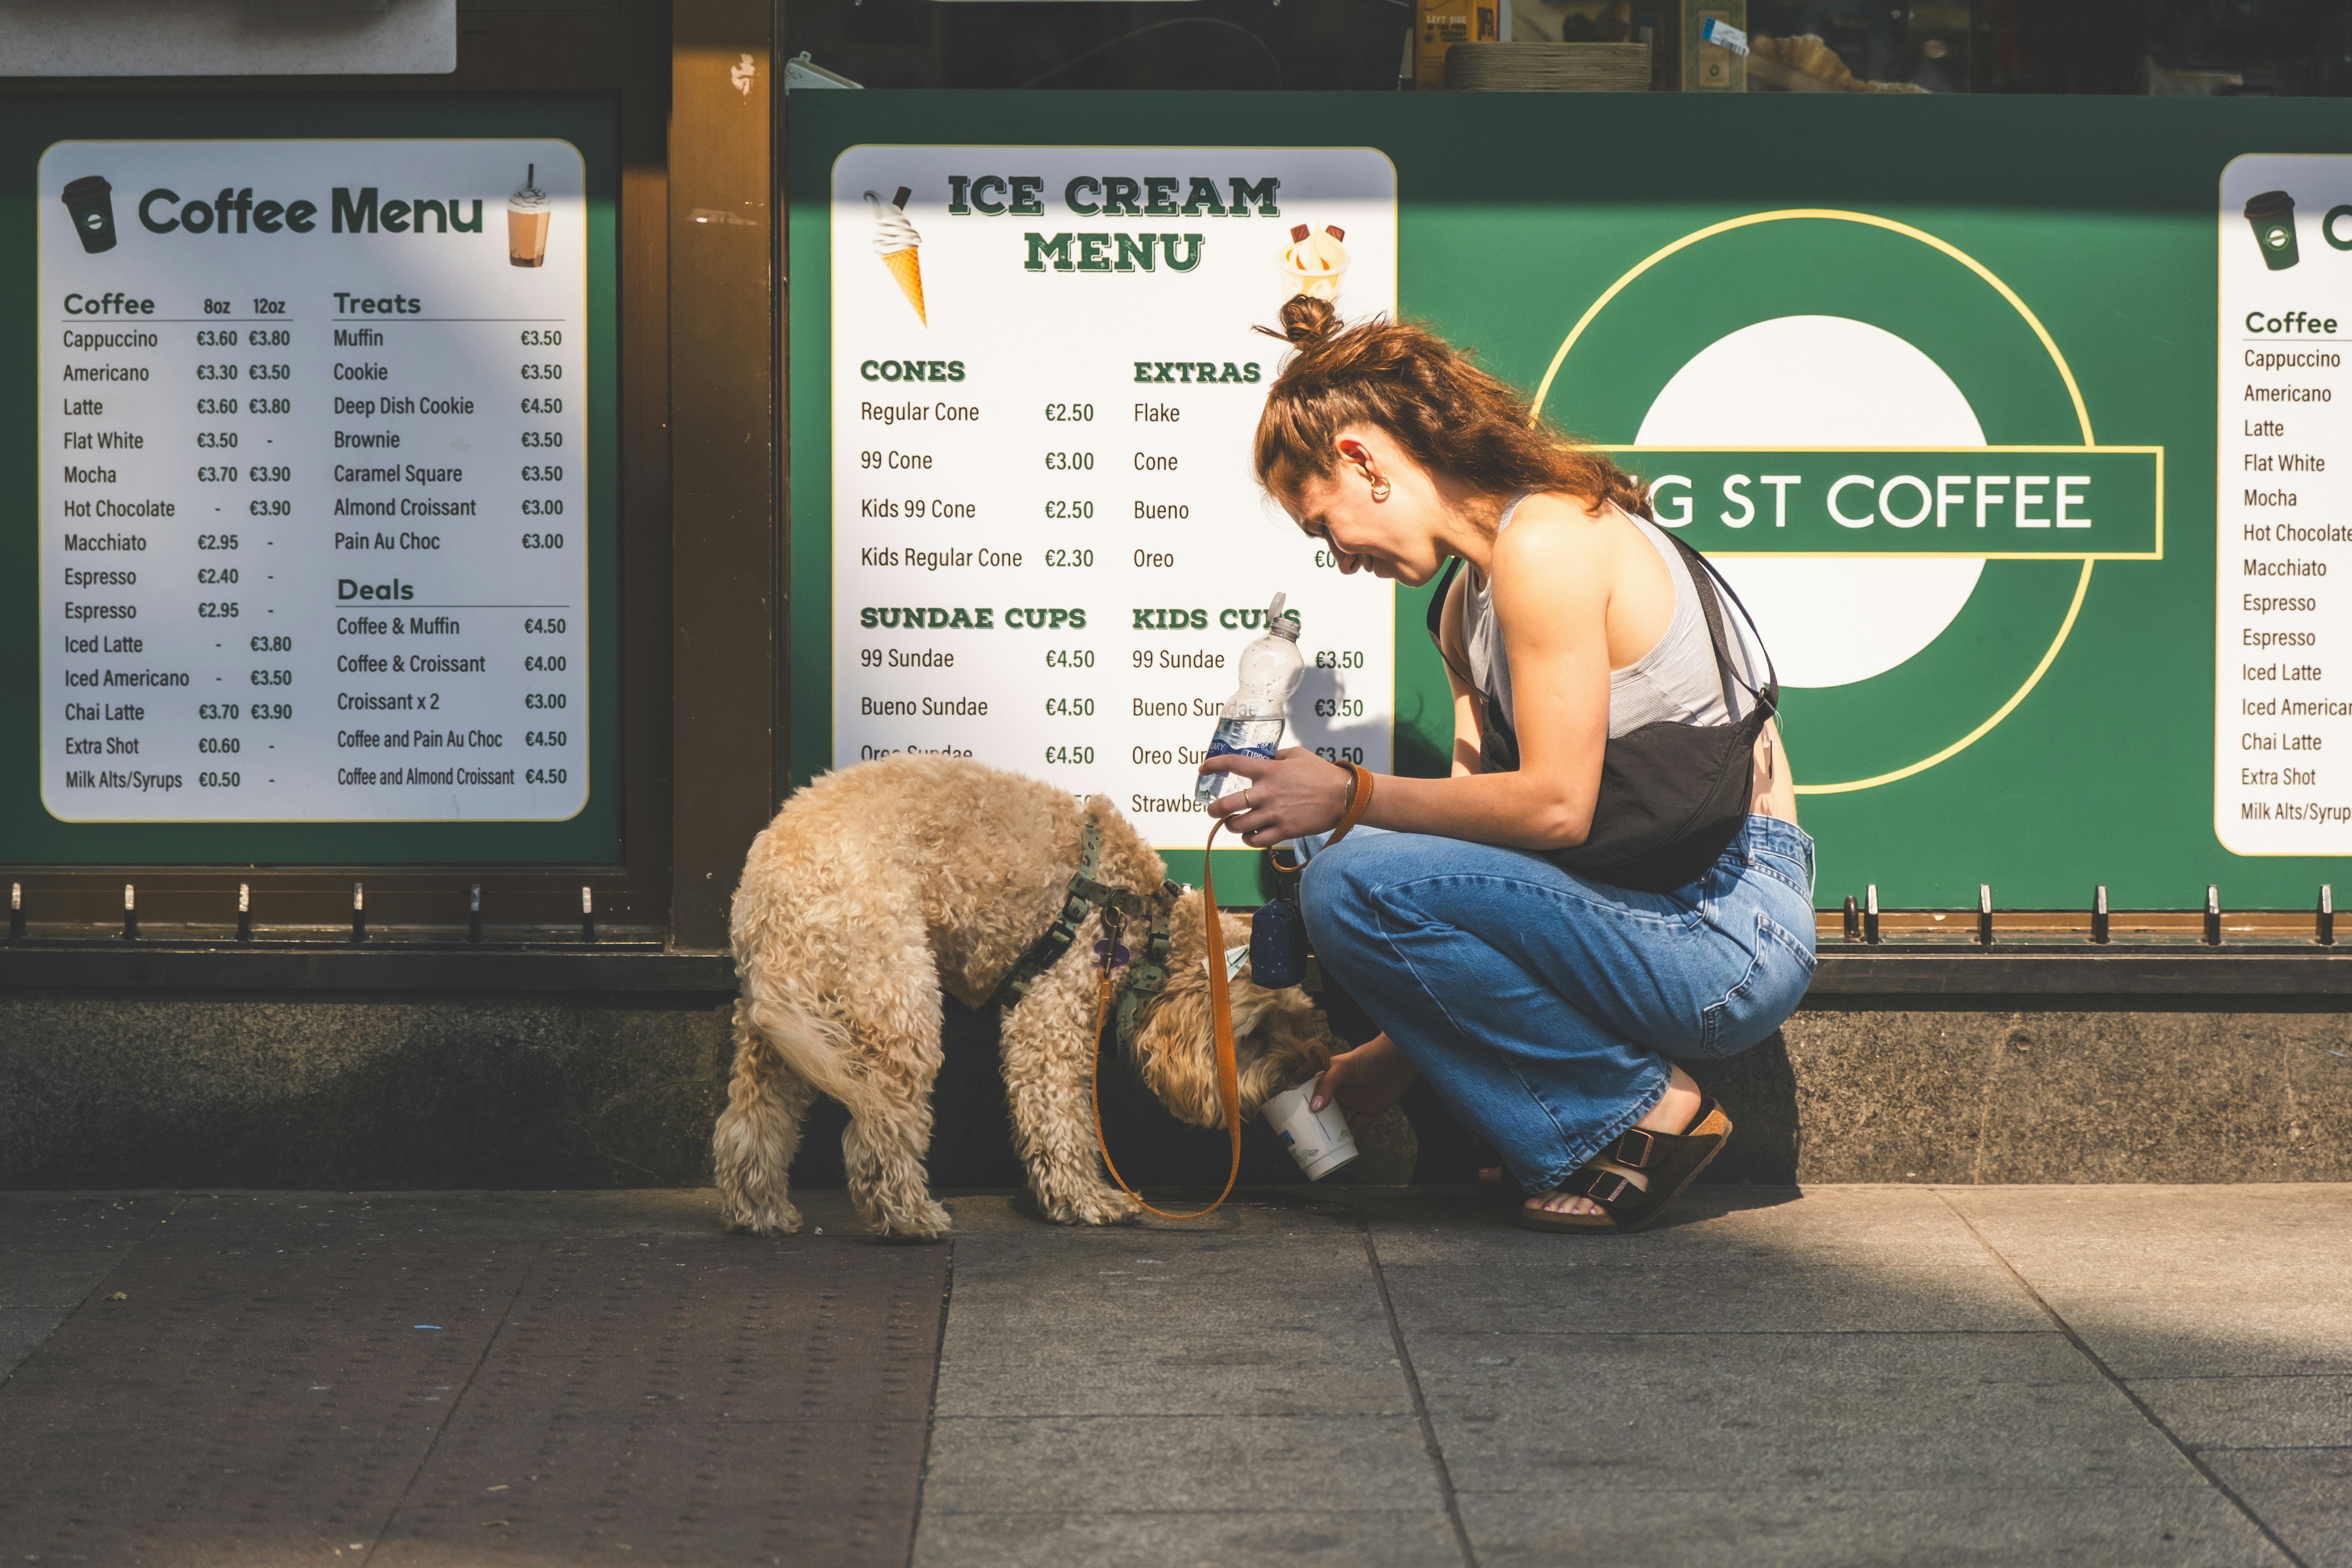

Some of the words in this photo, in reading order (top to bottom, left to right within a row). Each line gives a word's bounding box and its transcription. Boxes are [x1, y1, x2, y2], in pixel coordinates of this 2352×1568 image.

[948, 175, 1045, 217] ICE
[1064, 176, 1280, 218] CREAM
[139, 188, 317, 234] Coffee
[332, 187, 484, 233] Menu
[1024, 232, 1205, 273] MENU
[64, 292, 155, 315] Coffee
[204, 298, 231, 314] 8oz
[253, 298, 285, 314] 12oz
[333, 292, 421, 314] Treats
[2246, 311, 2338, 334] Coffee
[63, 329, 158, 351] Cappuccino
[196, 330, 238, 346] €3.60
[249, 330, 290, 346] €3.80
[334, 328, 383, 346] Muffin
[521, 330, 562, 346] €3.50
[2245, 349, 2340, 371] Cappuccino
[63, 363, 149, 381] Americano
[196, 364, 238, 380] €3.30
[249, 364, 290, 380] €3.50
[334, 362, 388, 381] Cookie
[521, 364, 562, 380] €3.50
[860, 360, 965, 382] CONES
[1134, 362, 1261, 383] EXTRAS
[2244, 384, 2331, 402] Americano
[64, 398, 103, 415] Latte
[197, 398, 238, 414] €3.60
[249, 398, 291, 414] €3.80
[334, 397, 375, 418] Deep
[380, 396, 415, 414] Dish
[420, 396, 474, 414] Cookie
[521, 398, 563, 414] €4.50
[862, 401, 929, 425] Regular
[935, 402, 979, 421] Cone
[1045, 403, 1094, 422] €2.50
[1135, 403, 1180, 422] Flake
[2245, 420, 2284, 437] Latte
[64, 432, 93, 449] Flat
[97, 431, 144, 449] White
[197, 432, 238, 448] €3.50
[334, 430, 400, 448] Brownie
[521, 432, 563, 447] €3.50
[861, 451, 882, 469] 99
[888, 450, 932, 469] Cone
[1045, 452, 1094, 470] €3.00
[1134, 452, 1178, 471] Cone
[64, 466, 116, 483] Mocha
[197, 466, 238, 482] €3.70
[249, 466, 291, 482] €3.90
[334, 464, 400, 482] Caramel
[405, 464, 462, 486] Square
[521, 466, 563, 481] €3.50
[64, 500, 91, 517] Hot
[96, 499, 175, 517] Chocolate
[250, 500, 291, 516] €3.90
[334, 498, 395, 516] Almond
[400, 498, 476, 516] Croissant
[521, 499, 564, 515] €3.00
[862, 498, 899, 518] Kids
[904, 499, 925, 518] 99
[932, 499, 975, 518] Cone
[1045, 501, 1093, 519] €2.50
[1135, 501, 1189, 519] Bueno
[1629, 474, 1693, 528] G
[1720, 474, 1801, 528] ST
[1827, 475, 2092, 528] COFFEE
[64, 533, 147, 551] Macchiato
[198, 534, 239, 550] €2.95
[335, 531, 369, 550] Pain
[374, 532, 395, 550] Au
[400, 531, 440, 550] Choc
[522, 533, 564, 549] €3.00
[2244, 524, 2271, 541] Hot
[2276, 524, 2352, 542] Chocolate
[862, 547, 899, 566] Kids
[905, 547, 973, 571] Regular
[978, 548, 1022, 567] Cone
[1045, 549, 1093, 567] €2.30
[1134, 549, 1174, 568] Oreo
[65, 568, 136, 589] Espresso
[198, 568, 239, 584] €2.40
[338, 578, 414, 600] Deals
[65, 602, 137, 623] Espresso
[198, 602, 239, 618] €2.95
[861, 607, 994, 629] SUNDAE
[1005, 608, 1086, 629] CUPS
[1132, 608, 1208, 629] KIDS
[337, 616, 387, 635] Coffee
[392, 617, 404, 635] &
[410, 616, 459, 635] Muffin
[524, 618, 566, 634] €4.50
[65, 635, 98, 653] Iced
[104, 635, 143, 653] Latte
[250, 636, 292, 652] €3.80
[337, 654, 388, 672] Coffee
[392, 655, 405, 672] &
[410, 654, 485, 672] Croissant
[524, 656, 567, 671] €4.00
[861, 649, 882, 667] 99
[888, 648, 954, 668] Sundae
[1046, 650, 1095, 668] €4.50
[1133, 650, 1153, 668] 99
[1159, 649, 1225, 668] Sundae
[1315, 651, 1363, 668] €3.50
[65, 669, 99, 687] Iced
[103, 669, 190, 687] Americano
[250, 670, 292, 686] €3.50
[2243, 663, 2276, 681] Iced
[2282, 664, 2321, 681] Latte
[337, 692, 413, 710] Croissant
[417, 697, 426, 710] x
[430, 693, 439, 710] 2
[525, 693, 567, 709] €3.00
[862, 697, 917, 715] Bueno
[922, 697, 988, 716] Sundae
[1046, 698, 1094, 716] €4.50
[1133, 698, 1187, 717] Bueno
[1315, 699, 1363, 717] €3.50
[65, 703, 100, 721] Chai
[105, 703, 144, 721] Latte
[199, 704, 239, 720] €3.70
[251, 704, 292, 720] €3.90
[66, 737, 102, 755] Extra
[106, 737, 139, 755] Shot
[198, 738, 240, 753] €0.60
[337, 729, 380, 748] Coffee
[384, 730, 409, 747] and
[414, 730, 443, 747] Pain
[446, 730, 464, 747] Au
[468, 730, 502, 747] Choc
[525, 731, 567, 747] €4.50
[2242, 733, 2276, 750] Chai
[2283, 733, 2322, 750] Latte
[861, 745, 900, 761] Ore
[1045, 746, 1094, 764] €4.50
[1132, 746, 1172, 764] Oreo
[1315, 747, 1363, 765] €350
[66, 770, 96, 788] Milk
[99, 770, 182, 792] Alts/Syrups
[199, 772, 240, 787] €0.50
[338, 767, 377, 786] Coffee
[380, 767, 403, 785] and
[406, 767, 453, 785] Almond
[457, 767, 514, 785] Croissant
[525, 769, 567, 784] €4.50
